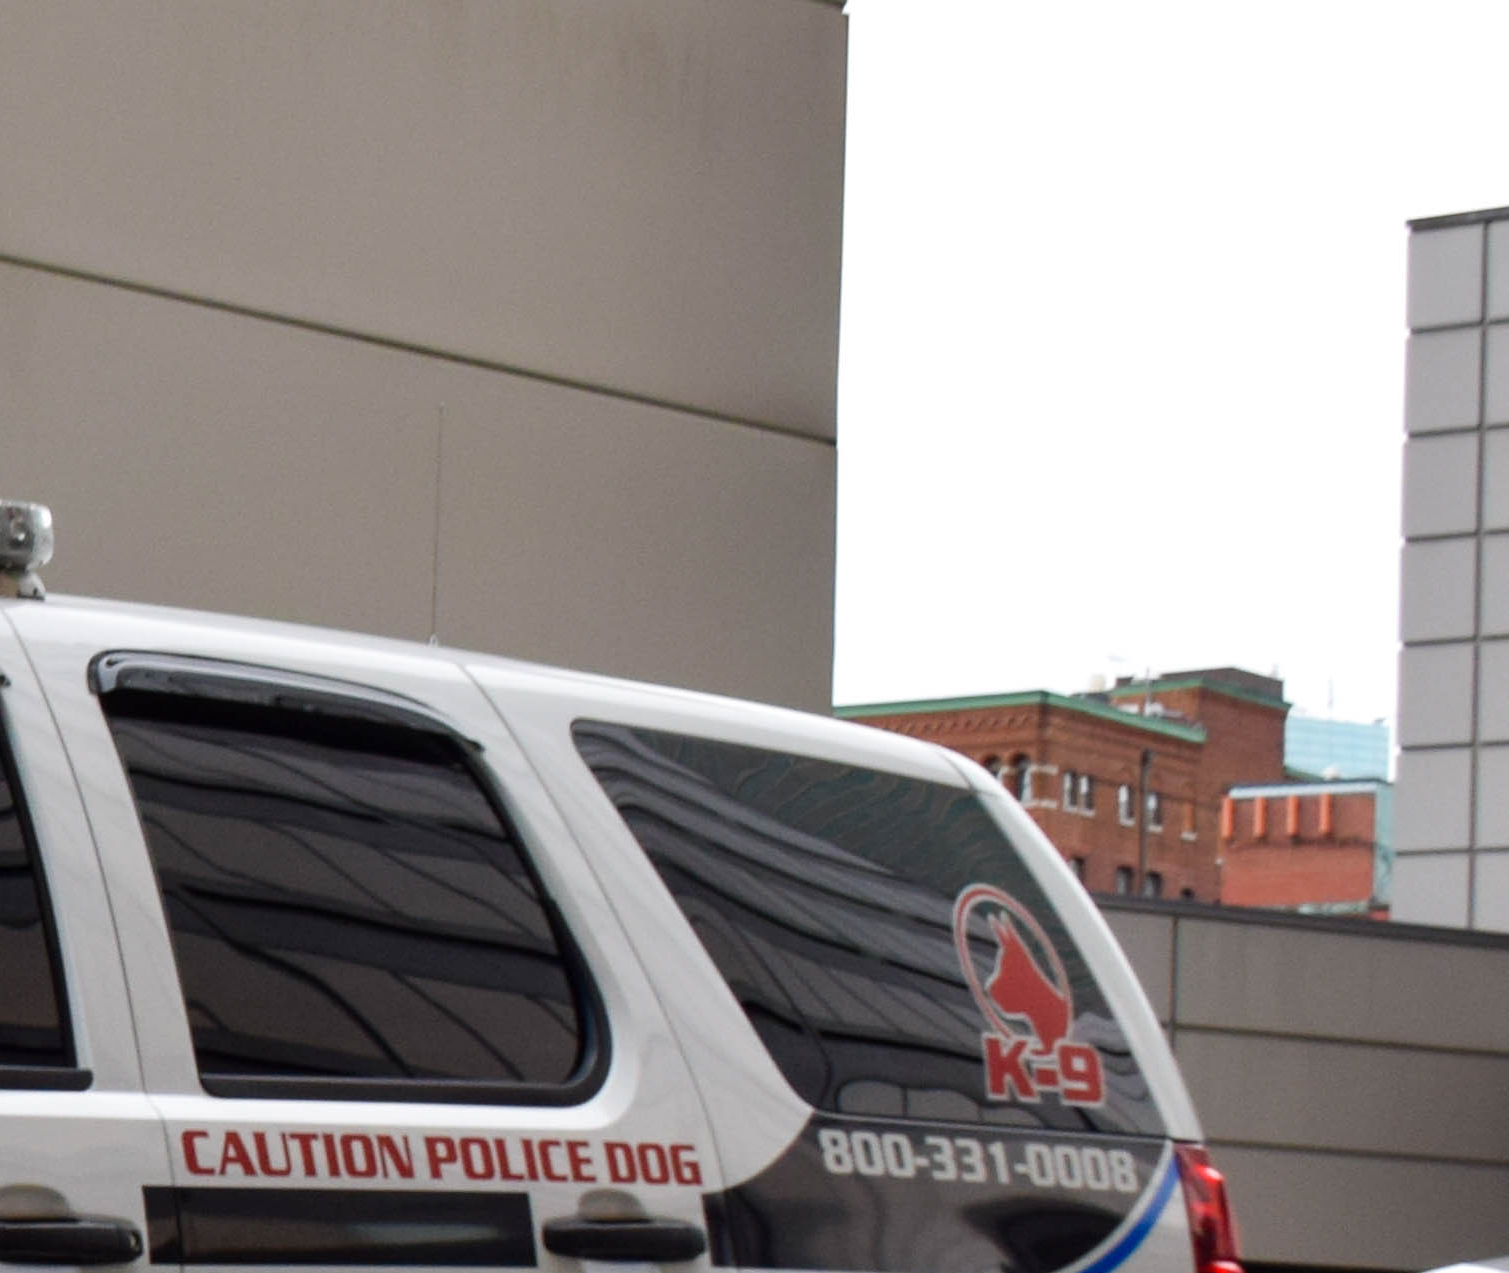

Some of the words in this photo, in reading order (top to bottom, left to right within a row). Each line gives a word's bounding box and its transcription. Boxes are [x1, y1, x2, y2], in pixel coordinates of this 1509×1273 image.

[983, 1034, 1105, 1107] K-9
[181, 1130, 414, 1178] CAUTION
[424, 1136, 596, 1182] POLICE
[604, 1141, 702, 1185] DOG
[818, 1129, 1138, 1191] 800-331-0008
